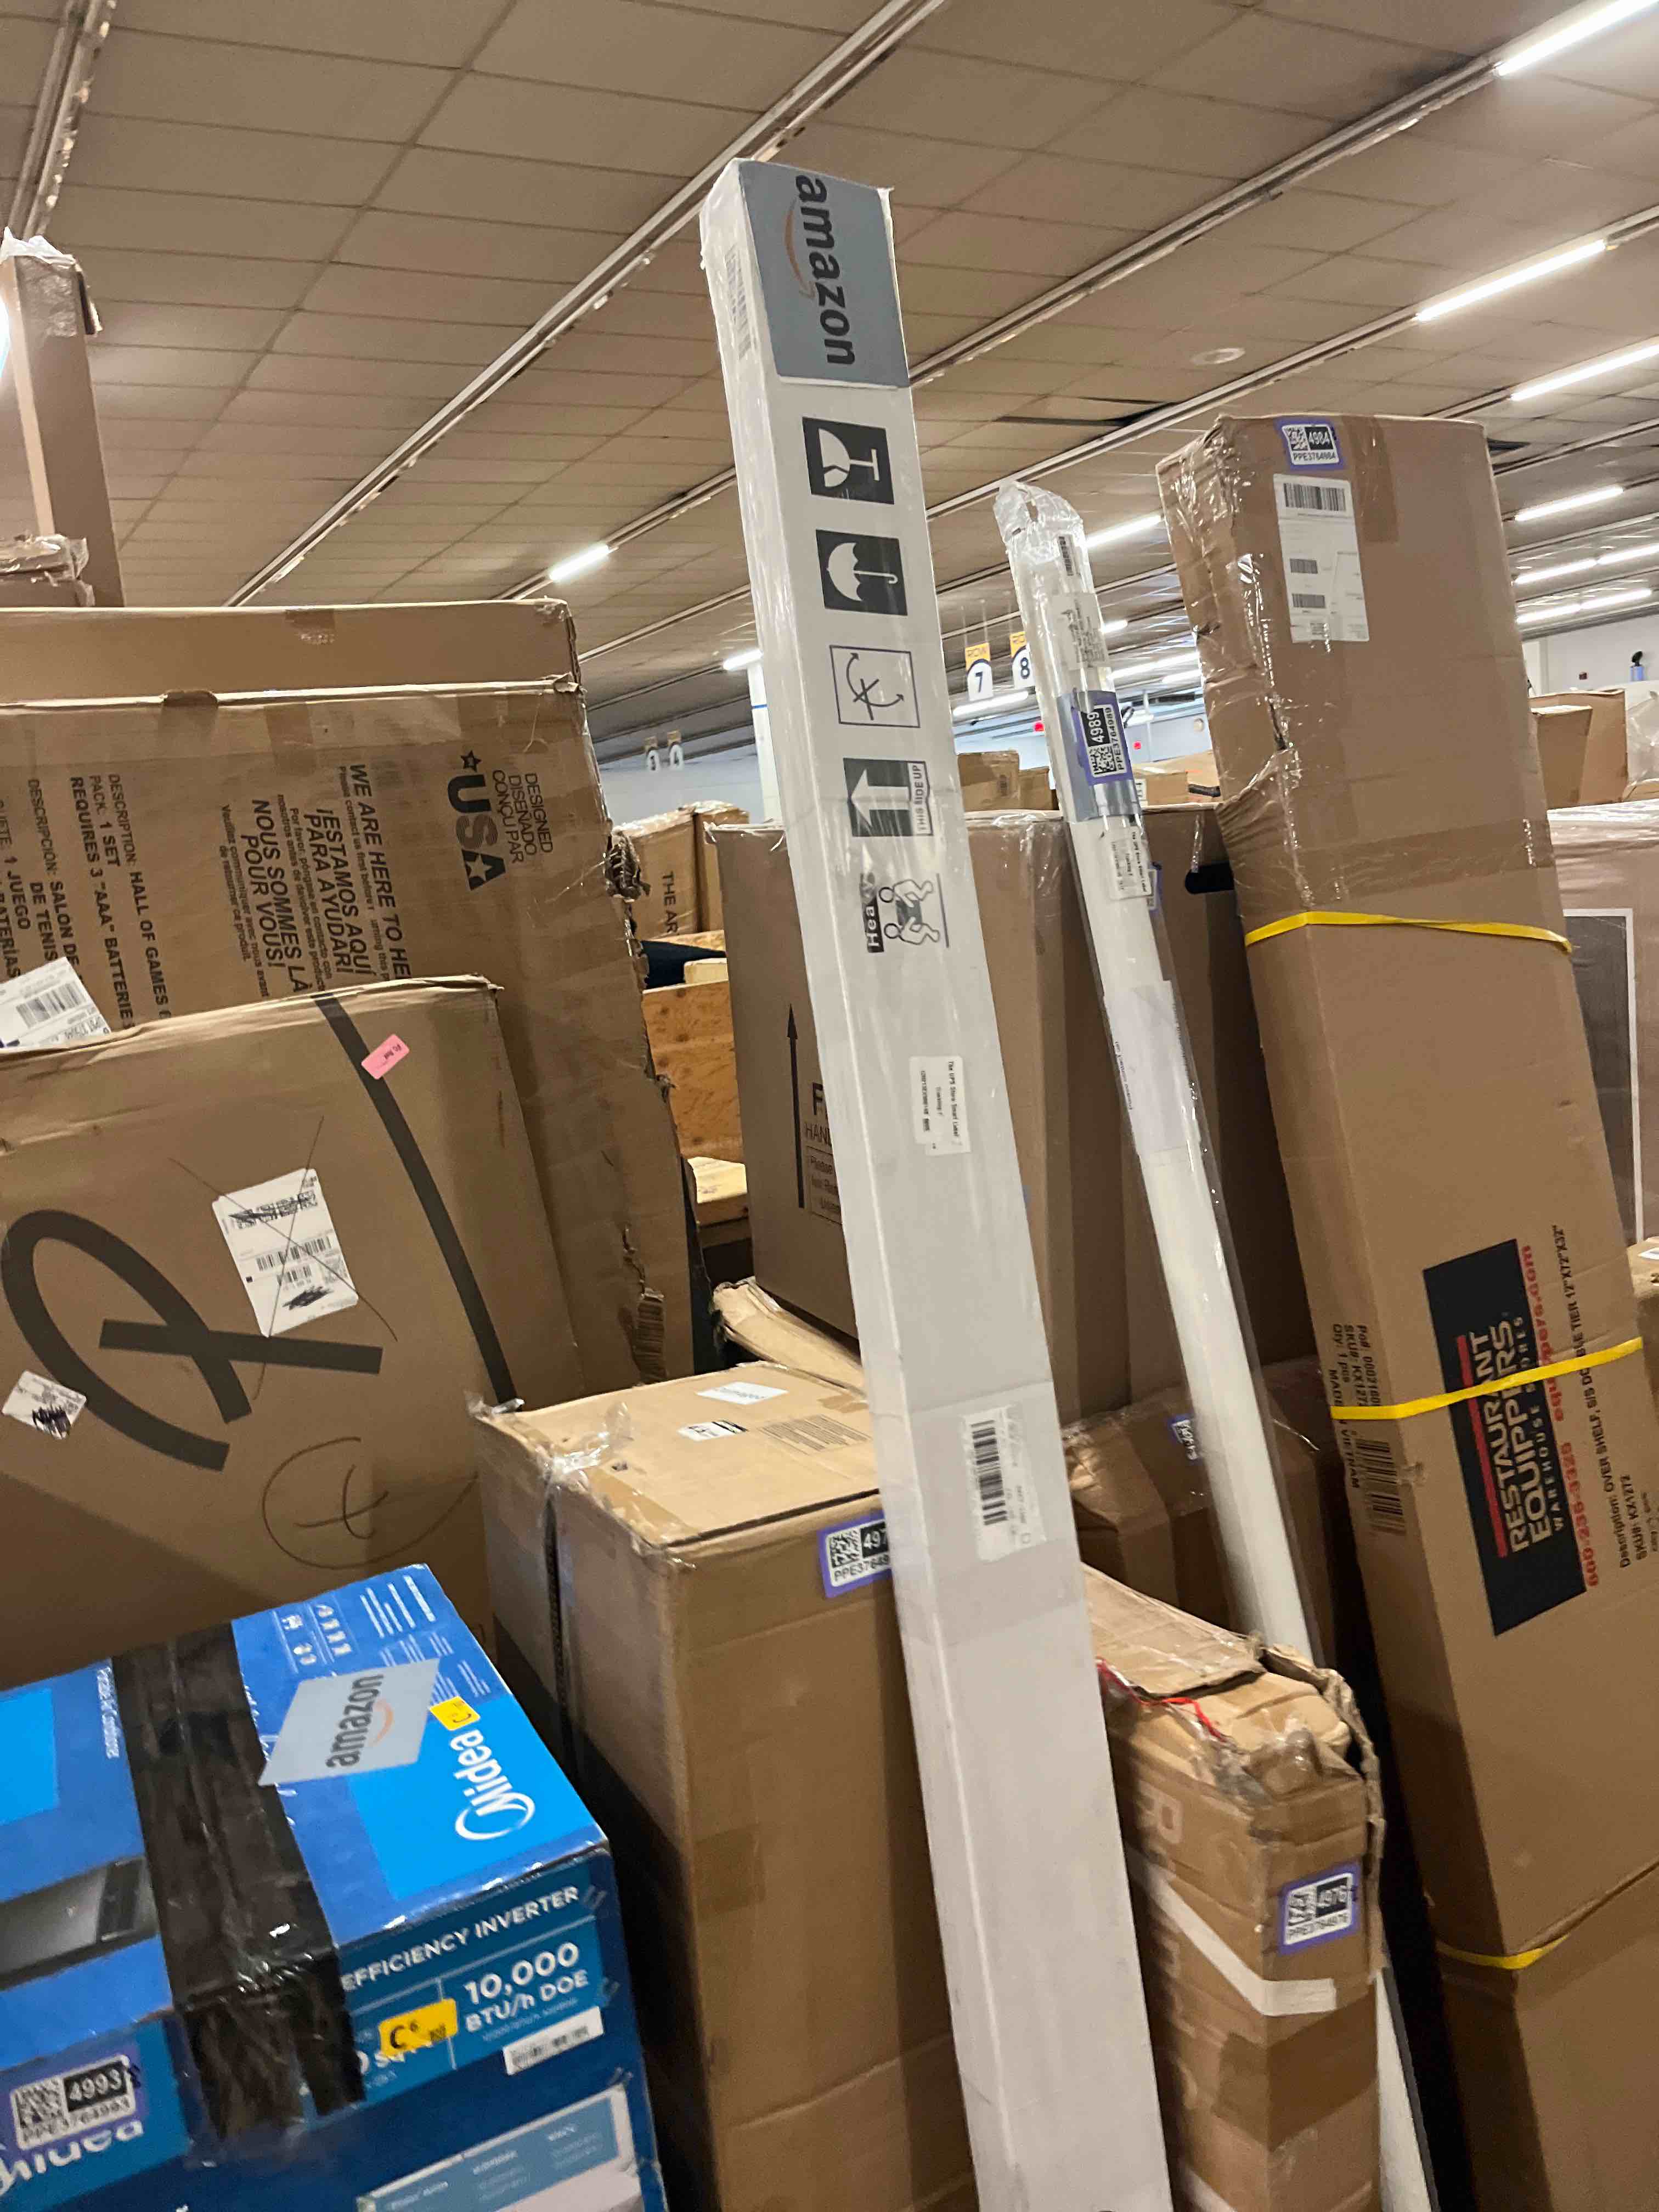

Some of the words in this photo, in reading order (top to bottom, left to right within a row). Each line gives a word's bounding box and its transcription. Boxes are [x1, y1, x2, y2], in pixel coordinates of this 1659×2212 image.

[795, 174, 856, 365] amazon
[974, 671, 984, 693] 7
[1020, 657, 1030, 680] 8
[1087, 712, 1105, 743] 4989
[1105, 707, 1124, 770] PPE3764989
[350, 764, 372, 797] WE
[912, 765, 924, 781] UP
[913, 782, 925, 806] SIDE
[71, 777, 99, 862] REQUIRES
[90, 868, 103, 878] 3
[109, 774, 136, 862] DESCRIPTION:
[277, 794, 292, 838] nosotros
[286, 840, 298, 867] antes
[292, 870, 303, 882] de
[345, 799, 359, 835] contact
[358, 802, 382, 845] ARE
[448, 775, 504, 888] USA
[492, 770, 514, 827] CONÇU
[505, 830, 524, 864] PAR
[509, 775, 537, 855] DISEÑADO
[525, 774, 553, 853] DESIGNED
[916, 807, 927, 831] THIS
[103, 836, 120, 866] SET
[353, 838, 362, 850] us
[357, 852, 367, 871] first
[7, 870, 31, 929] JUEGO
[30, 882, 46, 904] DE
[130, 872, 149, 915] HALL
[241, 835, 269, 895] POUR
[256, 902, 285, 967] VOUS!
[252, 800, 280, 859] NOUS
[267, 867, 301, 958] SOMMES
[287, 966, 313, 992] LÀ
[289, 808, 300, 825] Por
[313, 916, 328, 958] contacto
[323, 961, 332, 979] con
[304, 814, 331, 871] PARA
[318, 879, 353, 973] AYUDAR!
[317, 809, 358, 917] ¡ESTAMOS
[346, 923, 376, 975] AQUÍ
[369, 851, 396, 907] HERE
[662, 870, 676, 906] THE
[36, 910, 58, 961] TENIS
[140, 920, 155, 941] OF
[383, 914, 403, 941] TO
[62, 943, 81, 967] DE
[145, 947, 168, 1005] GAMES
[1568, 1301, 1581, 1330] TIER
[1515, 1318, 1537, 1392] SORES
[1589, 1410, 1607, 1454] SHELF,
[1531, 1407, 1563, 1531] WAREHOUSE
[1599, 1457, 1614, 1492] OVER
[863, 1527, 887, 1549] 497
[834, 1553, 888, 1581] PPE37649
[326, 1674, 383, 1768] amazon
[449, 1729, 536, 1840] Midea
[341, 1927, 470, 1991] EFFICIENCY
[475, 1886, 579, 1939] INVERTER
[464, 1942, 579, 2005] 10,000
[466, 1993, 536, 2033] BTU/h
[540, 1969, 590, 2002] DOE
[69, 2068, 122, 2101] 4993
